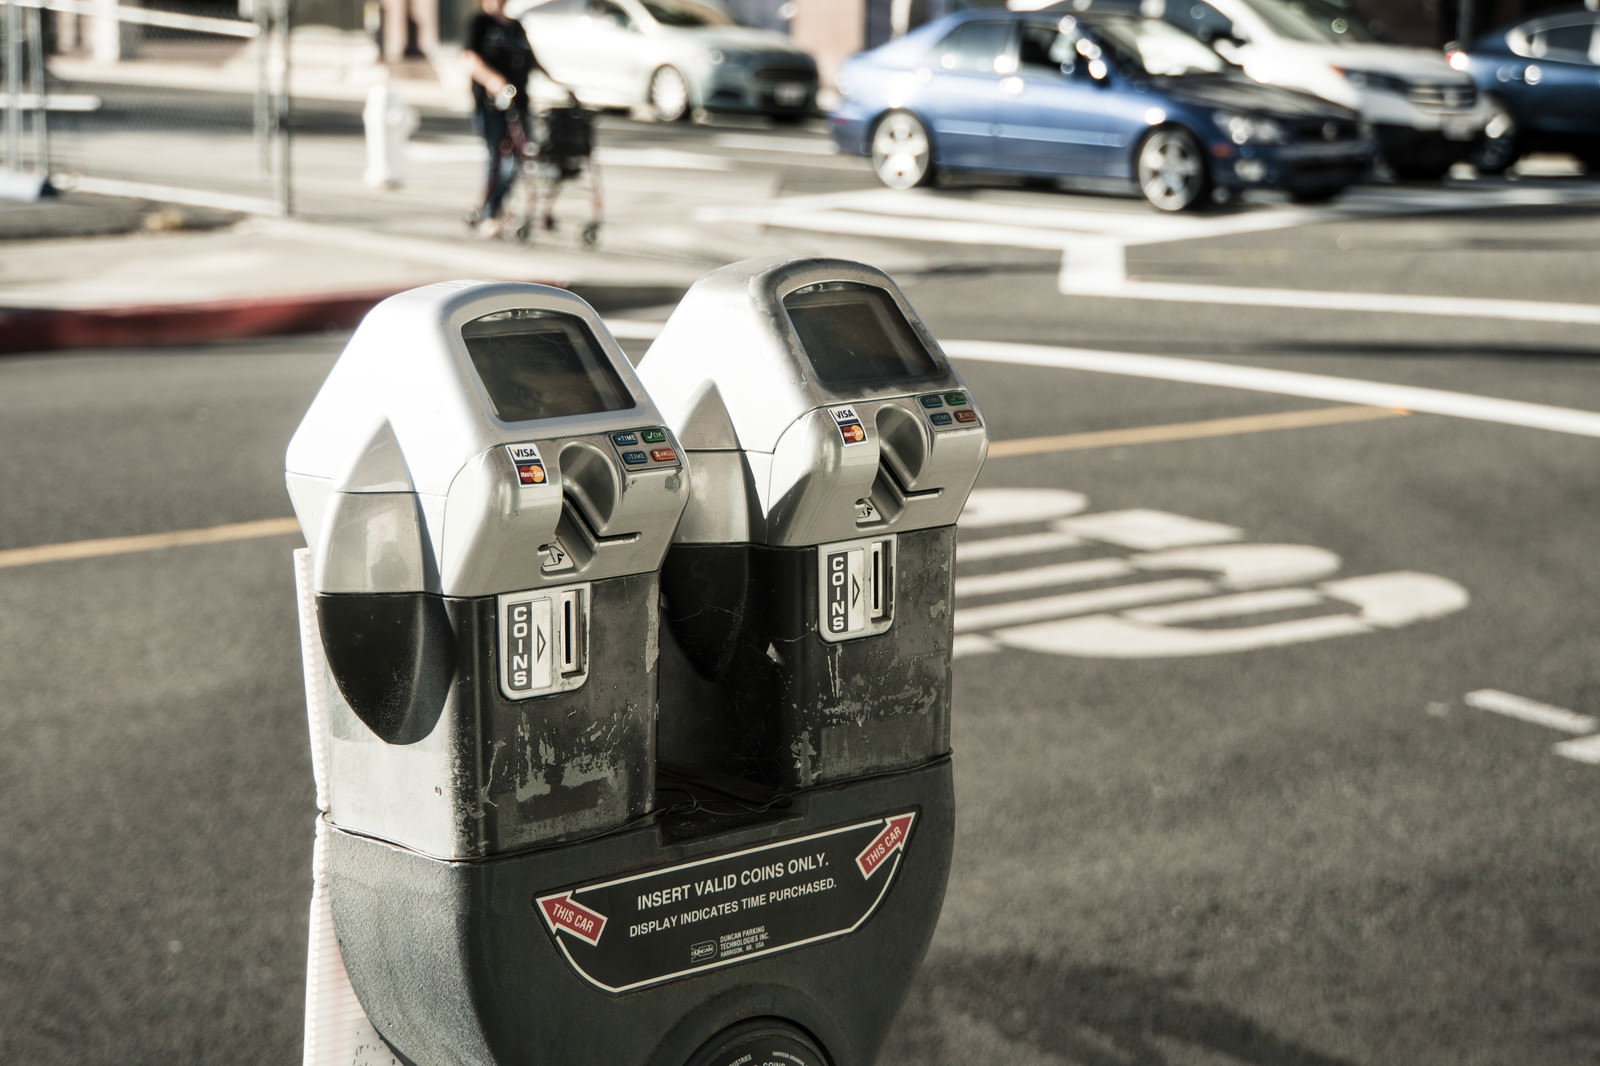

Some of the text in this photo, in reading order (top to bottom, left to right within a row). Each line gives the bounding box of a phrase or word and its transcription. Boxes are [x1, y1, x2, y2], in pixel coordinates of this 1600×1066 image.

[835, 409, 855, 419] VISA
[513, 448, 537, 457] VISA
[832, 556, 845, 631] COINS
[513, 606, 528, 687] COINS
[865, 825, 902, 867] THIS CAR
[637, 852, 829, 911] INSERT VALID COINS ONLY.
[552, 903, 594, 934] THIS CAR
[629, 877, 837, 938] DISPLAY INDICATES TIME PURCHASED.
[720, 925, 765, 943] DUNCAN PARKING
[720, 936, 759, 950] TECHNOLOGIES
